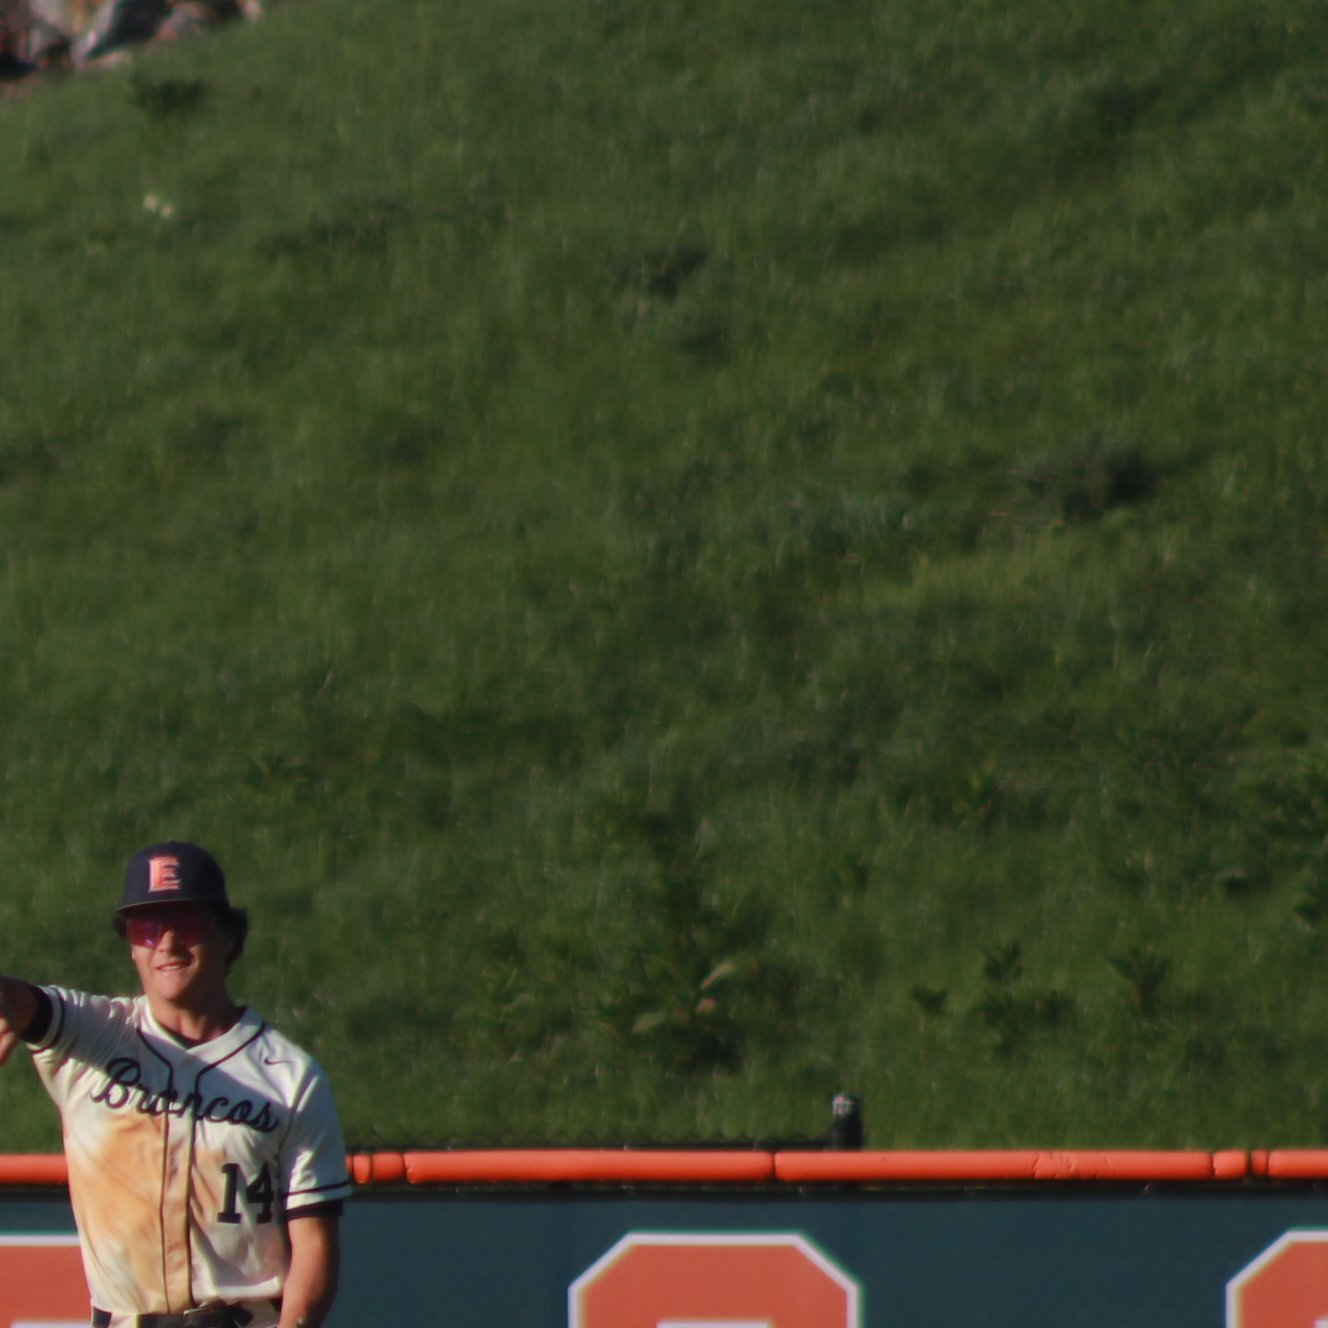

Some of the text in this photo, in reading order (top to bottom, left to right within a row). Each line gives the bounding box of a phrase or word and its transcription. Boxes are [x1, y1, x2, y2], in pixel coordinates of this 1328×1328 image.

[148, 855, 181, 893] E
[91, 1057, 279, 1133] Broncos
[216, 1163, 275, 1225] 14
